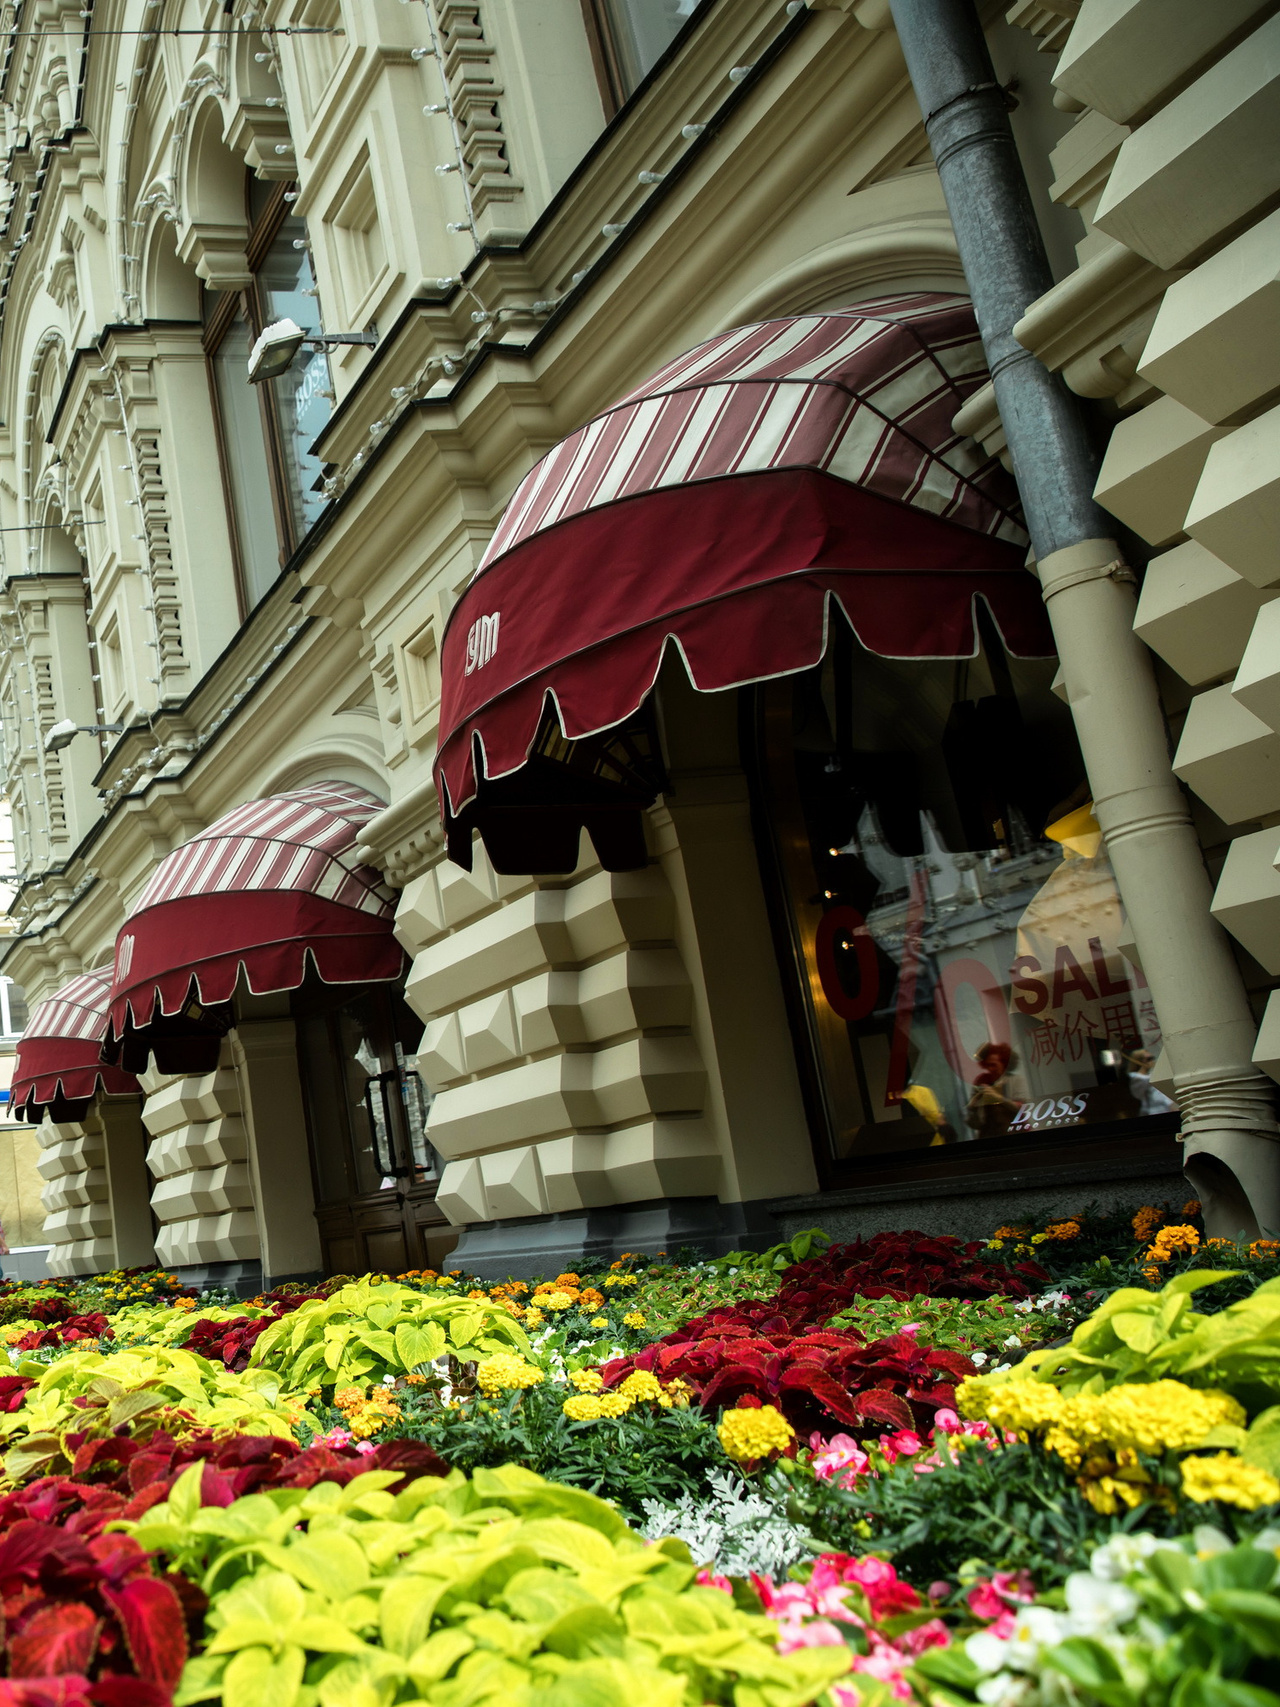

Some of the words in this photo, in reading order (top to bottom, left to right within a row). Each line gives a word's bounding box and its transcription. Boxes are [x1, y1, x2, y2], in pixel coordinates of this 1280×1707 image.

[295, 355, 326, 414] BOSS
[1007, 1121, 1040, 1133] HUGO
[1045, 1116, 1080, 1127] BOSS
[1010, 1092, 1090, 1125] BOSS
